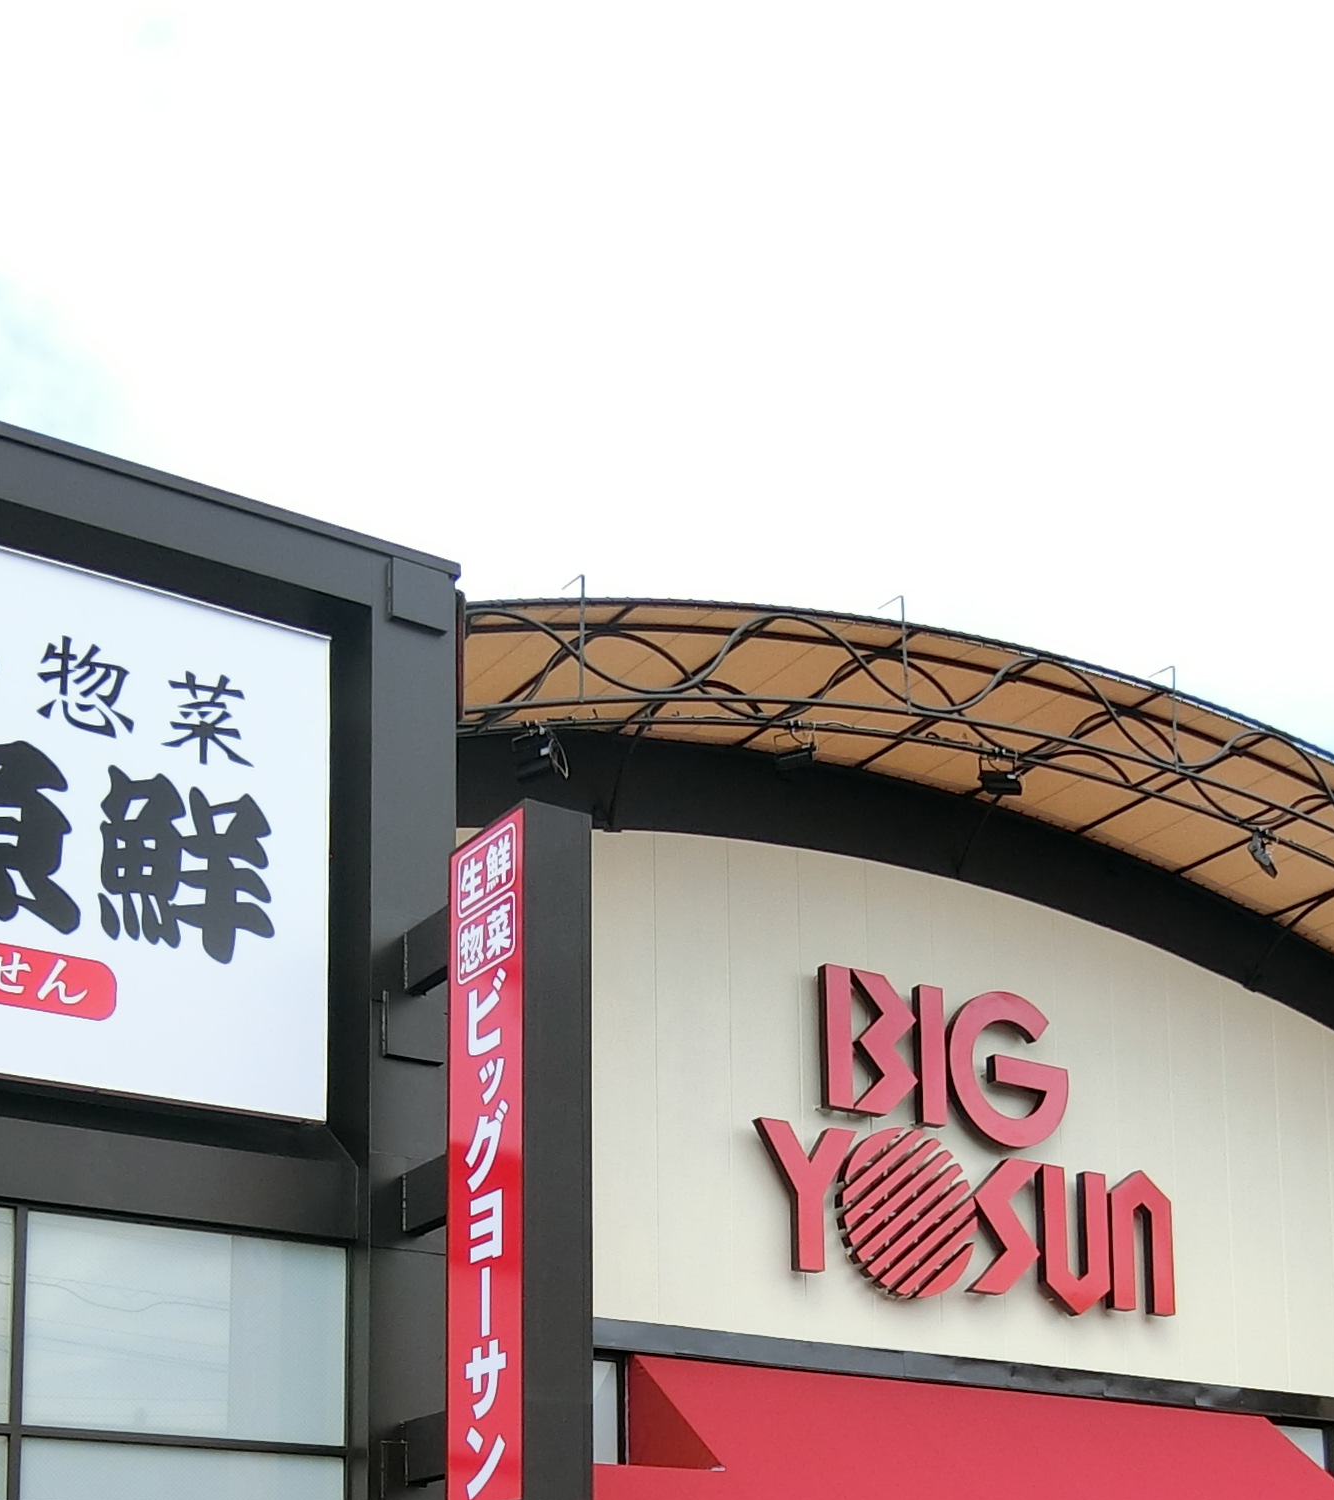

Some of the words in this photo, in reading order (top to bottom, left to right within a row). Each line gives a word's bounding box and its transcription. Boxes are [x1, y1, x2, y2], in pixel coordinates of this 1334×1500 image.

[817, 963, 1069, 1149] BIG
[464, 967, 508, 1500] ビッグヨーサン
[751, 1116, 1176, 1317] YOSUN
